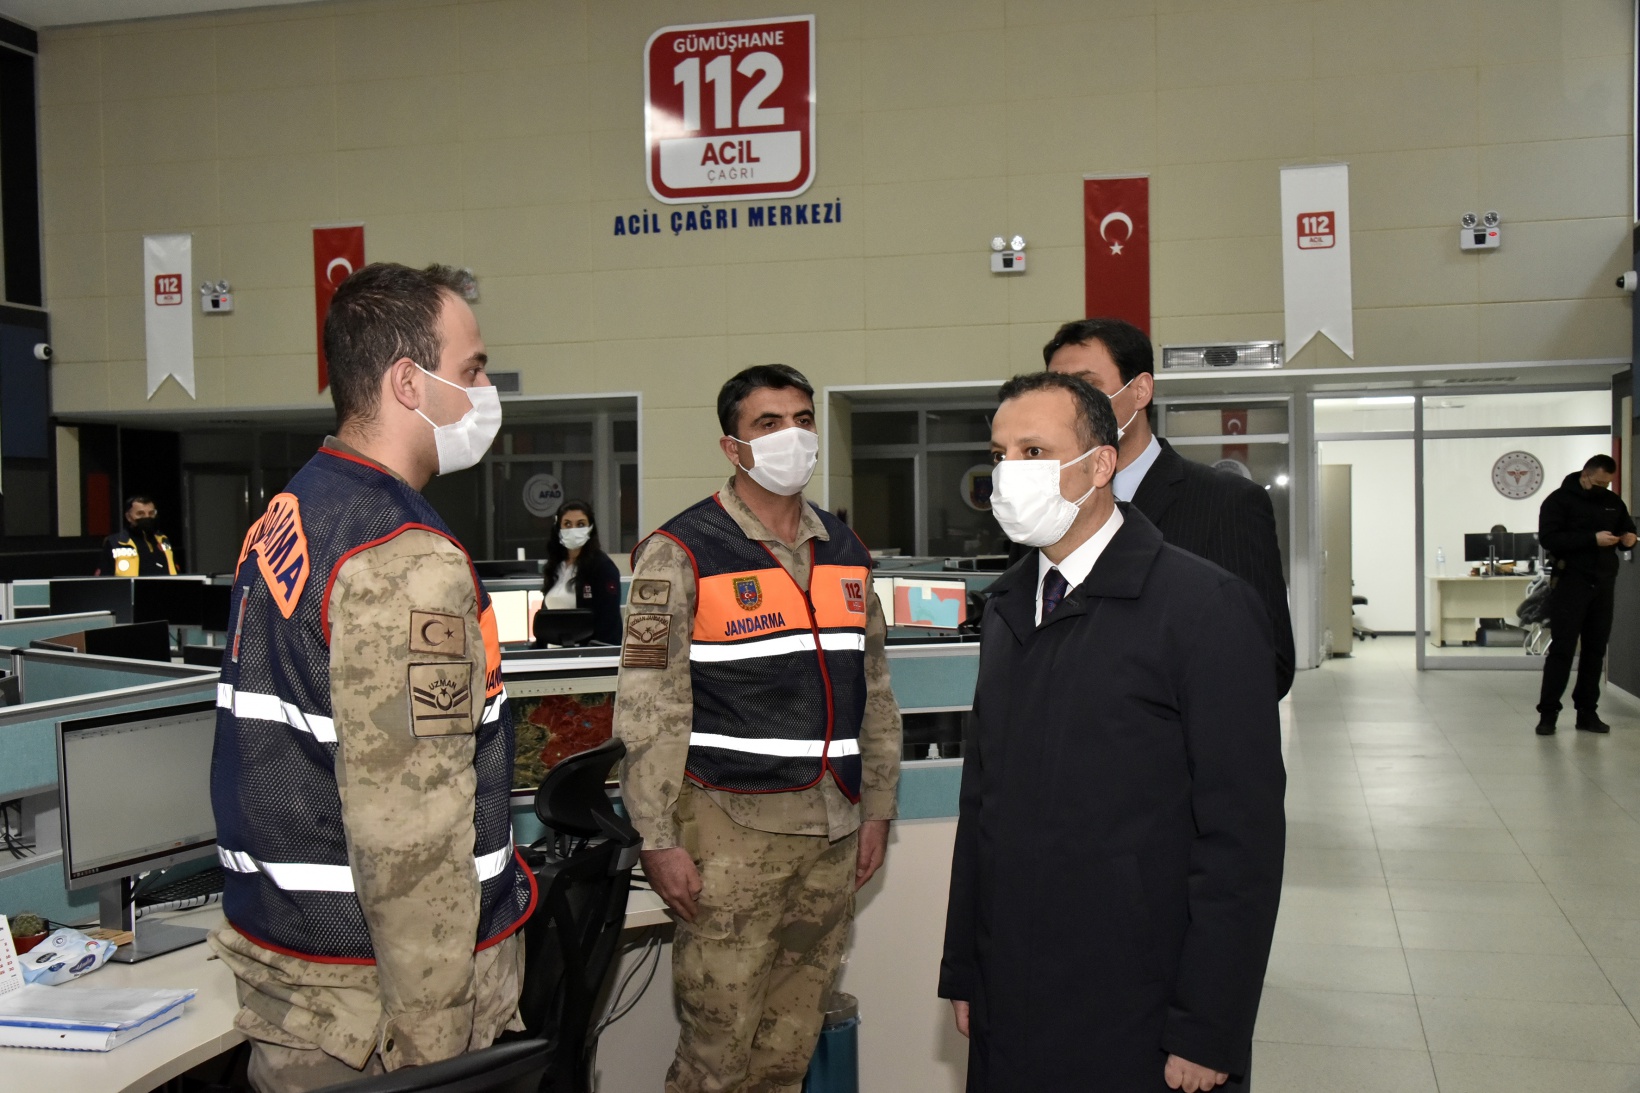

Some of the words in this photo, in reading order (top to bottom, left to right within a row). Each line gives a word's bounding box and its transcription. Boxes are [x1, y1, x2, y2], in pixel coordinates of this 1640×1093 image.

[673, 31, 784, 53] GÜMÜŞHANE
[673, 51, 785, 131] 112
[707, 167, 754, 184] ÇAĞRI
[614, 209, 661, 236] ACİL
[670, 205, 738, 236] ÇAĞRI
[748, 198, 842, 227] MERKEZİ
[1302, 215, 1330, 234] 112
[158, 277, 179, 293] 112
[539, 490, 561, 499] AFAD
[845, 582, 862, 599] 112
[725, 612, 786, 636] JANDARMA
[428, 679, 457, 690] UZMAN
